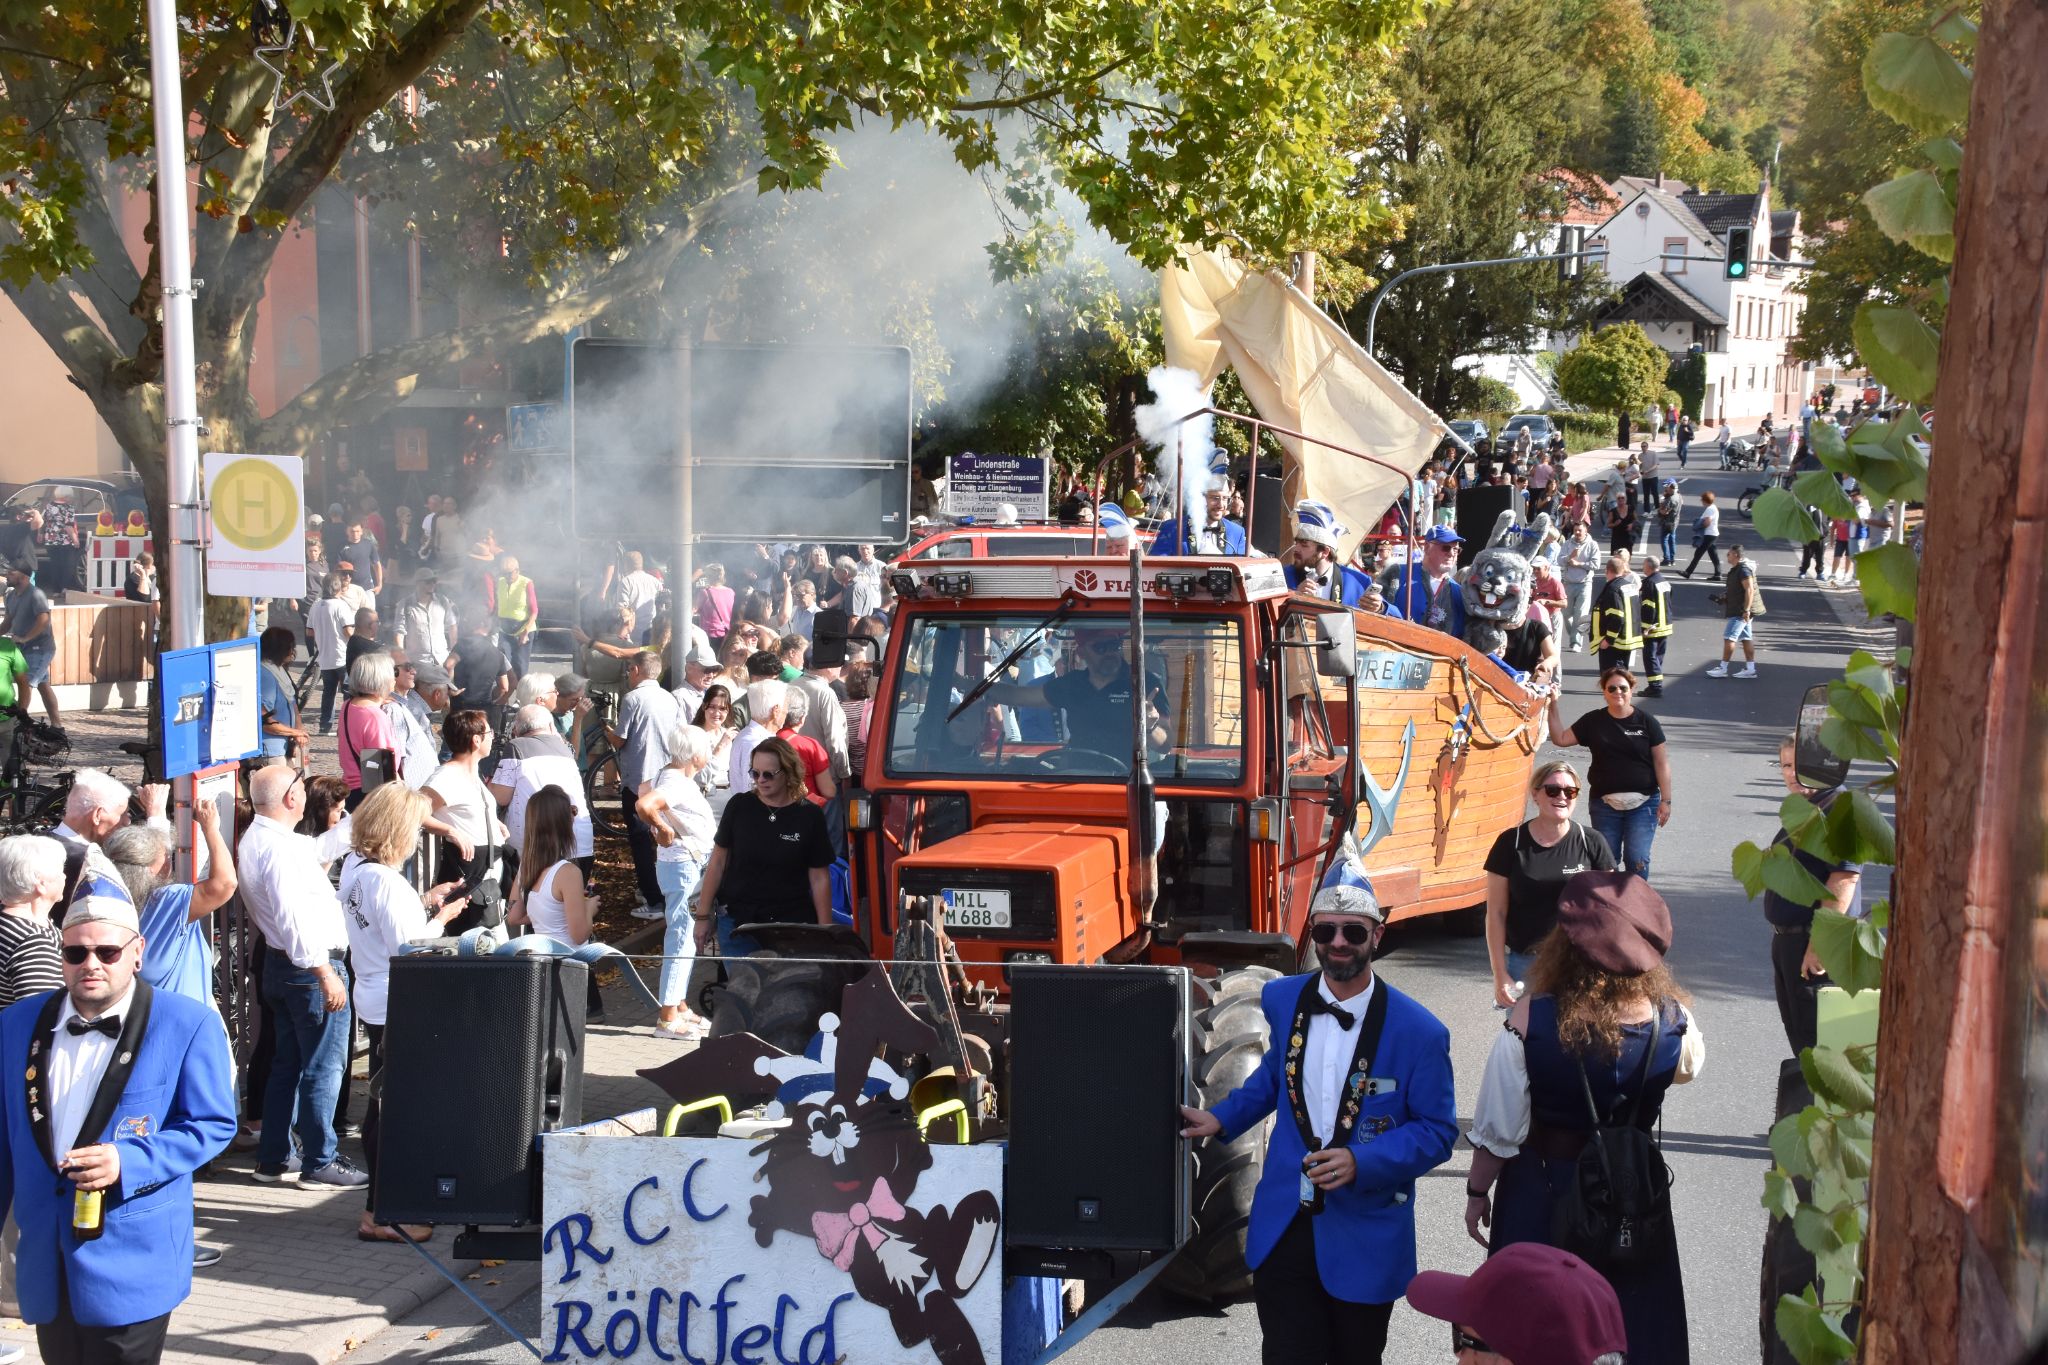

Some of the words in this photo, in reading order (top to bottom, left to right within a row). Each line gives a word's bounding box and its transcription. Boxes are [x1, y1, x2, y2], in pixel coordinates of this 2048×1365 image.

[974, 460, 1020, 469] Lindenstraße
[992, 473, 1040, 481] Heimatmuseum
[954, 483, 977, 492] Fußweg
[236, 479, 272, 530] H
[954, 892, 987, 908] MIL
[945, 909, 956, 924] M
[961, 910, 991, 925] 688
[543, 1157, 729, 1284] RCC
[542, 1274, 854, 1365] Röllfeld
